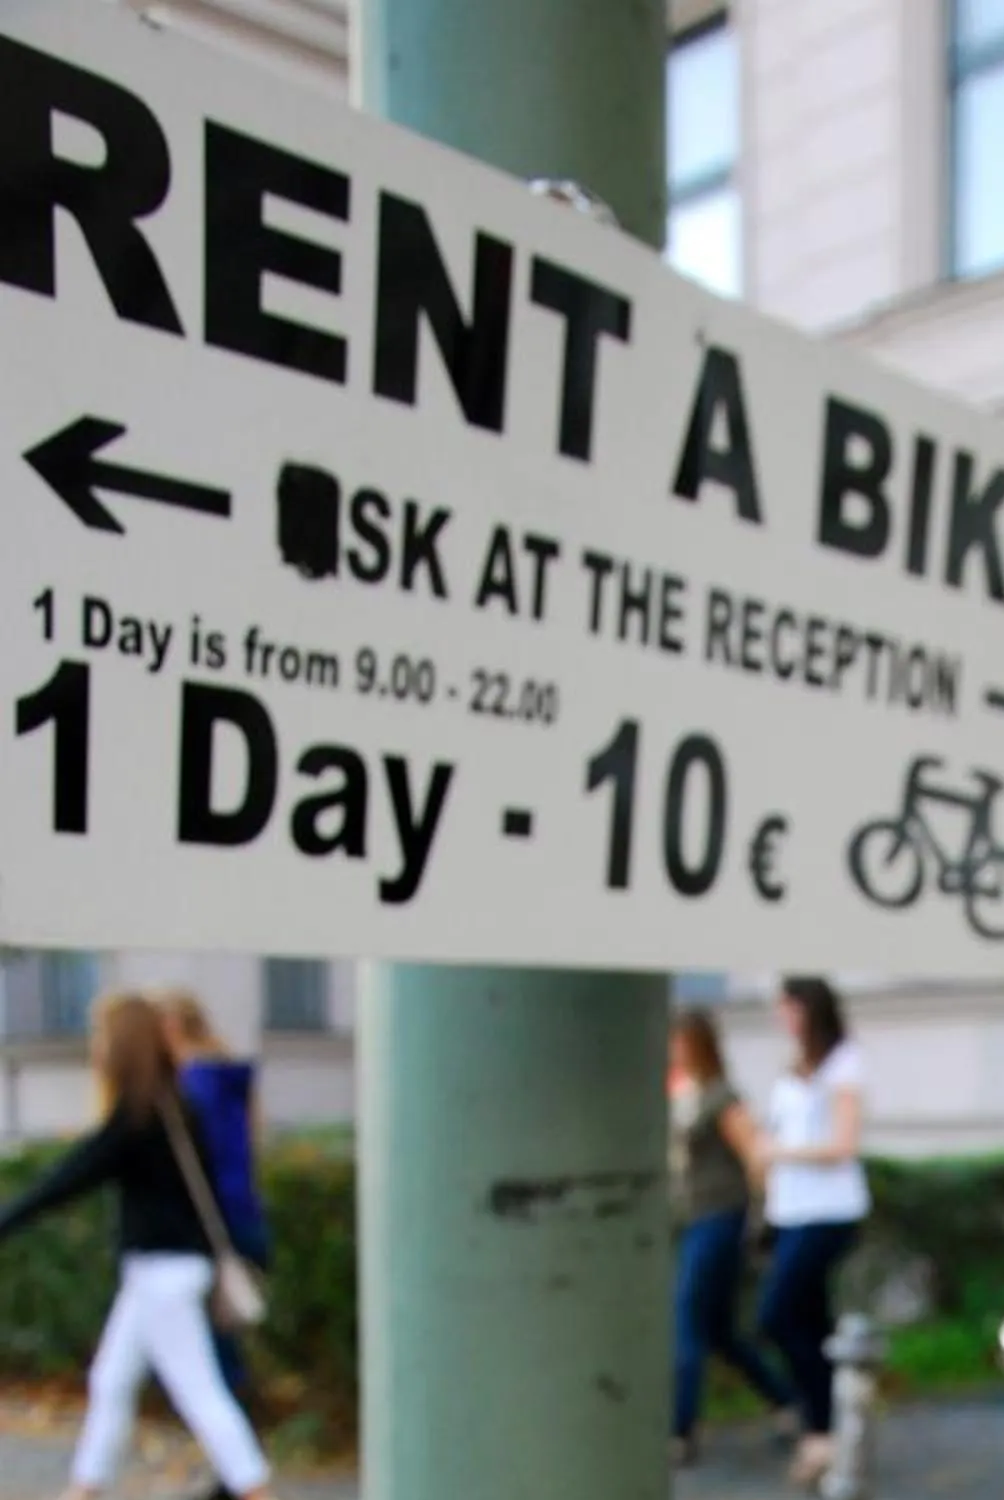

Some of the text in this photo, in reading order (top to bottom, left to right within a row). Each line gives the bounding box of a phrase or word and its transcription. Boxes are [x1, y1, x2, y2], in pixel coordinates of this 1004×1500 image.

[0, 32, 634, 465] RENT
[671, 342, 764, 526] A
[33, 587, 55, 642] 1
[81, 594, 173, 675] Day
[189, 613, 228, 671] is
[242, 624, 340, 689] from
[355, 646, 436, 705] 9.00
[469, 667, 558, 726] 22.00
[275, 459, 958, 715] SK AT THE RECEPTION
[14, 658, 91, 836] 1
[176, 678, 456, 906] Day
